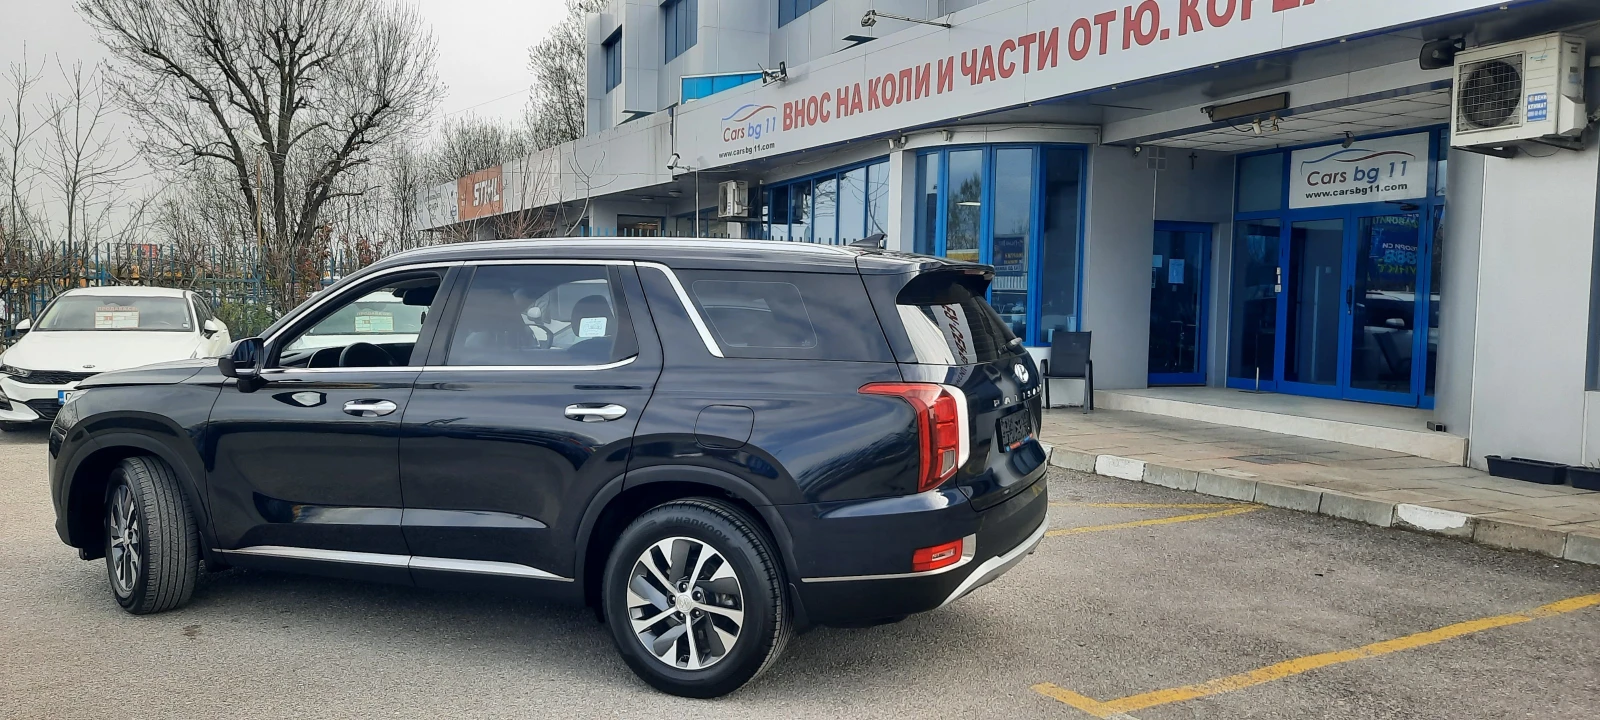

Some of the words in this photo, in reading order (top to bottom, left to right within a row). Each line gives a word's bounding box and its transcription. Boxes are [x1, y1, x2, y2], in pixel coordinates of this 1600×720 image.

[782, 91, 831, 132] ВНОС
[836, 82, 864, 119] НА
[867, 61, 931, 111] КОЛИ
[936, 55, 955, 95] И
[960, 27, 1059, 85] ЧАСТИ
[1067, 9, 1117, 62] ОТ
[723, 127, 745, 142] Cars
[748, 122, 762, 140] bg
[766, 116, 776, 134] 11
[1306, 170, 1347, 187] Cars
[1353, 165, 1380, 184] bg
[1389, 160, 1408, 178] 11
[473, 176, 500, 207] STIHL
[1305, 182, 1408, 199] www.carsbg11.com
